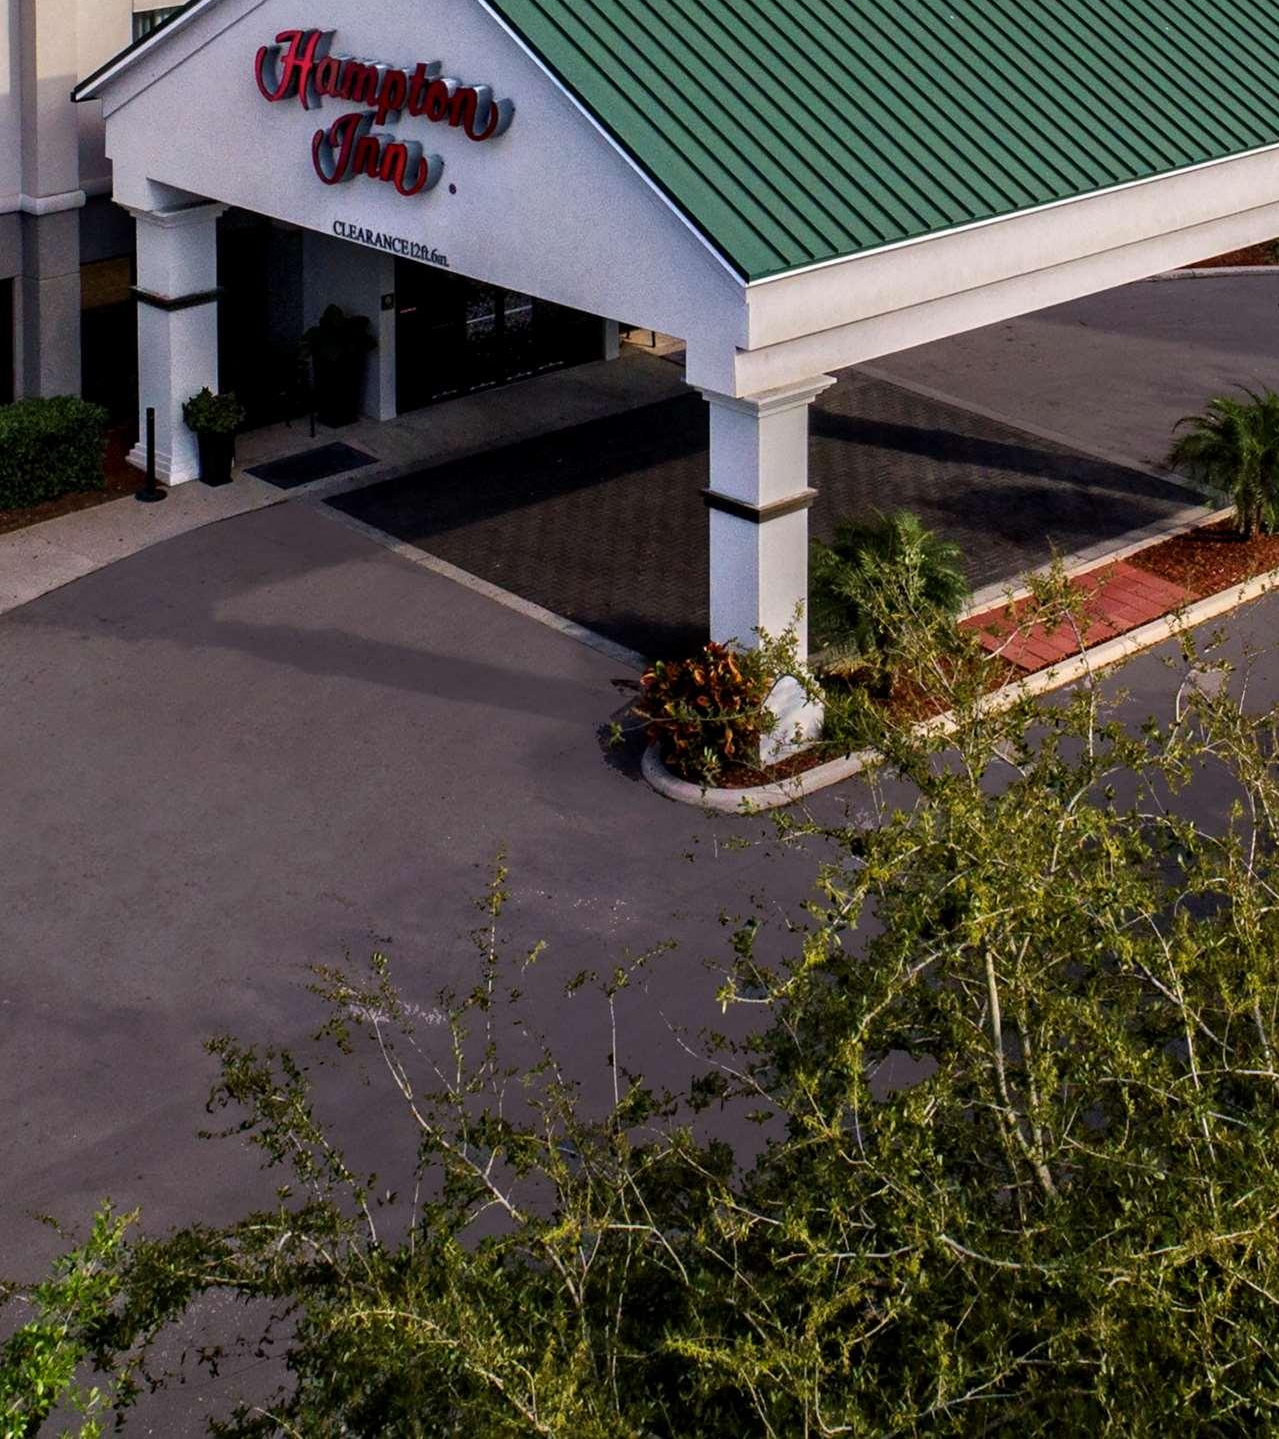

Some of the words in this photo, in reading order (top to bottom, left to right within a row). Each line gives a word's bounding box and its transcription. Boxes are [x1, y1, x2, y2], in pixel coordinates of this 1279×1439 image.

[255, 29, 508, 141] Hampton
[312, 111, 437, 196] Inn
[333, 220, 409, 256] CLEARANCE
